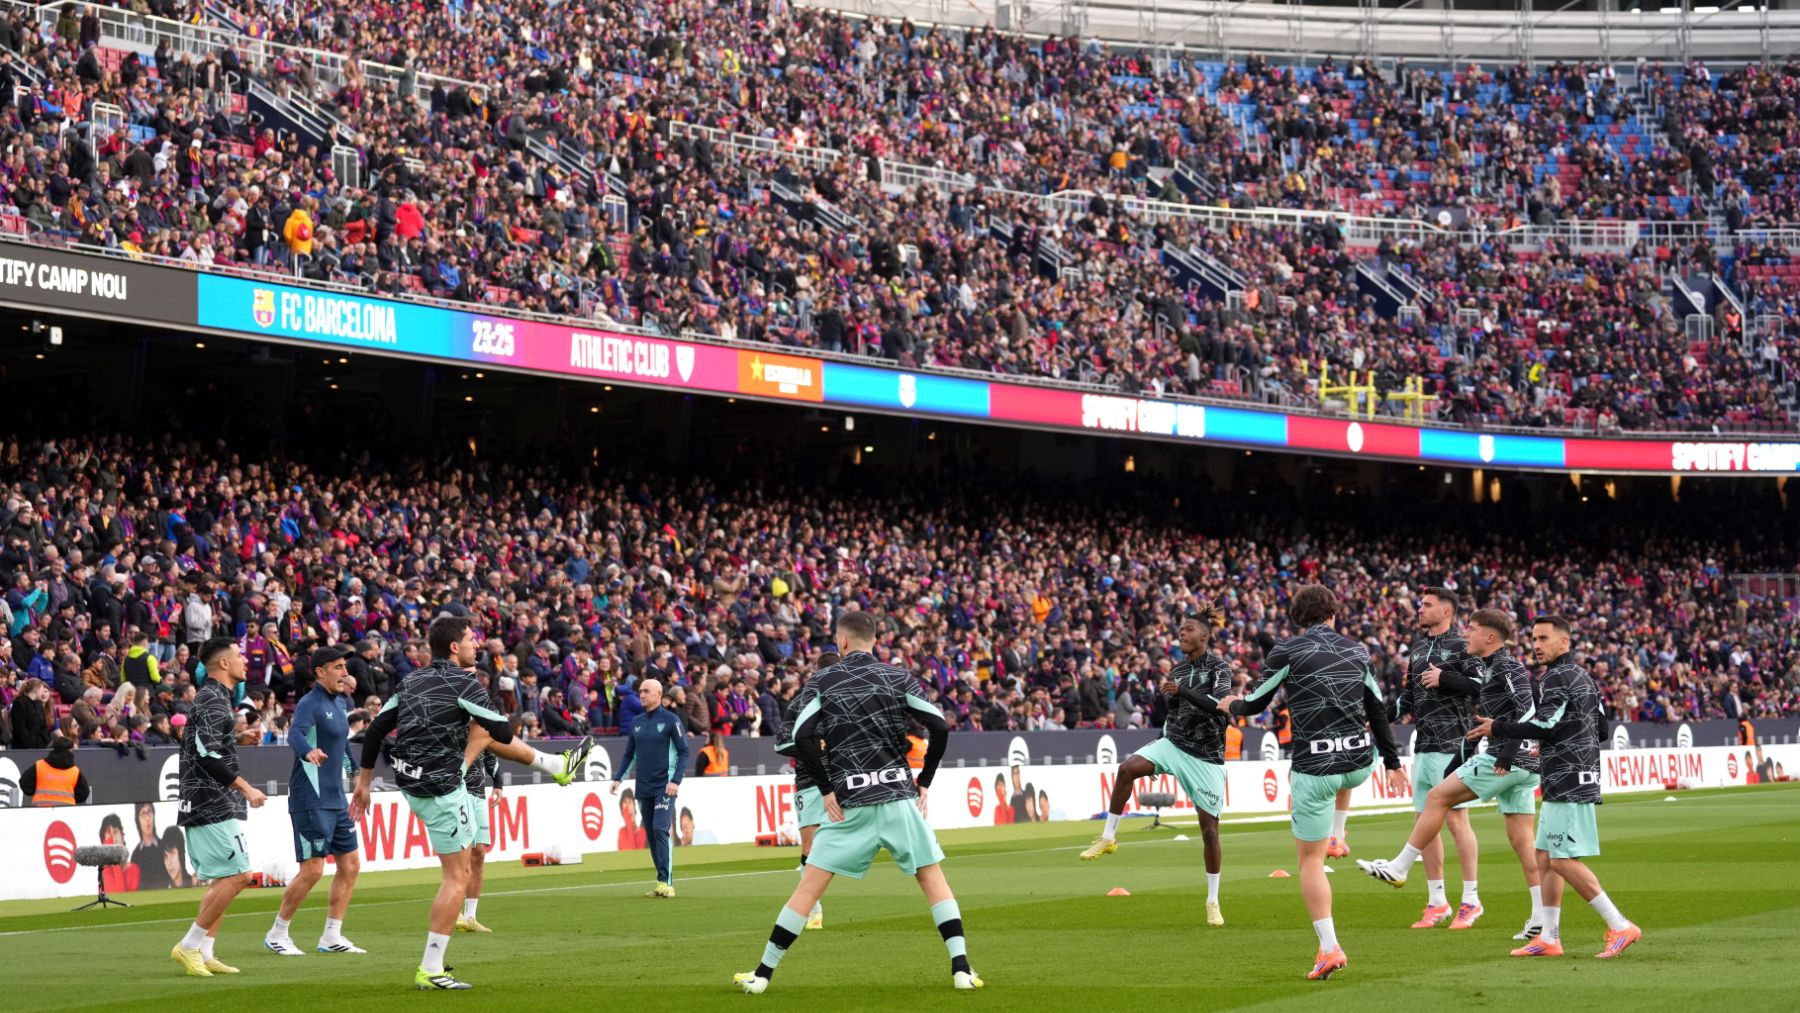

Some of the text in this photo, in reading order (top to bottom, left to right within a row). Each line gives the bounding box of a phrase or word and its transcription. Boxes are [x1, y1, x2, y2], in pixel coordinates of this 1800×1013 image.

[38, 263, 88, 294] CAMP
[91, 271, 127, 301] NOU
[281, 292, 396, 344] FC BARCELONA
[472, 320, 514, 356] 23:25
[570, 333, 670, 378] ATHLETIC CLUB
[1672, 442, 1746, 471] SPOTIFY
[1309, 732, 1371, 754] DIGI
[846, 768, 907, 790] DIGI
[1608, 752, 1704, 788] NEW ALBUM
[459, 806, 468, 825] 3
